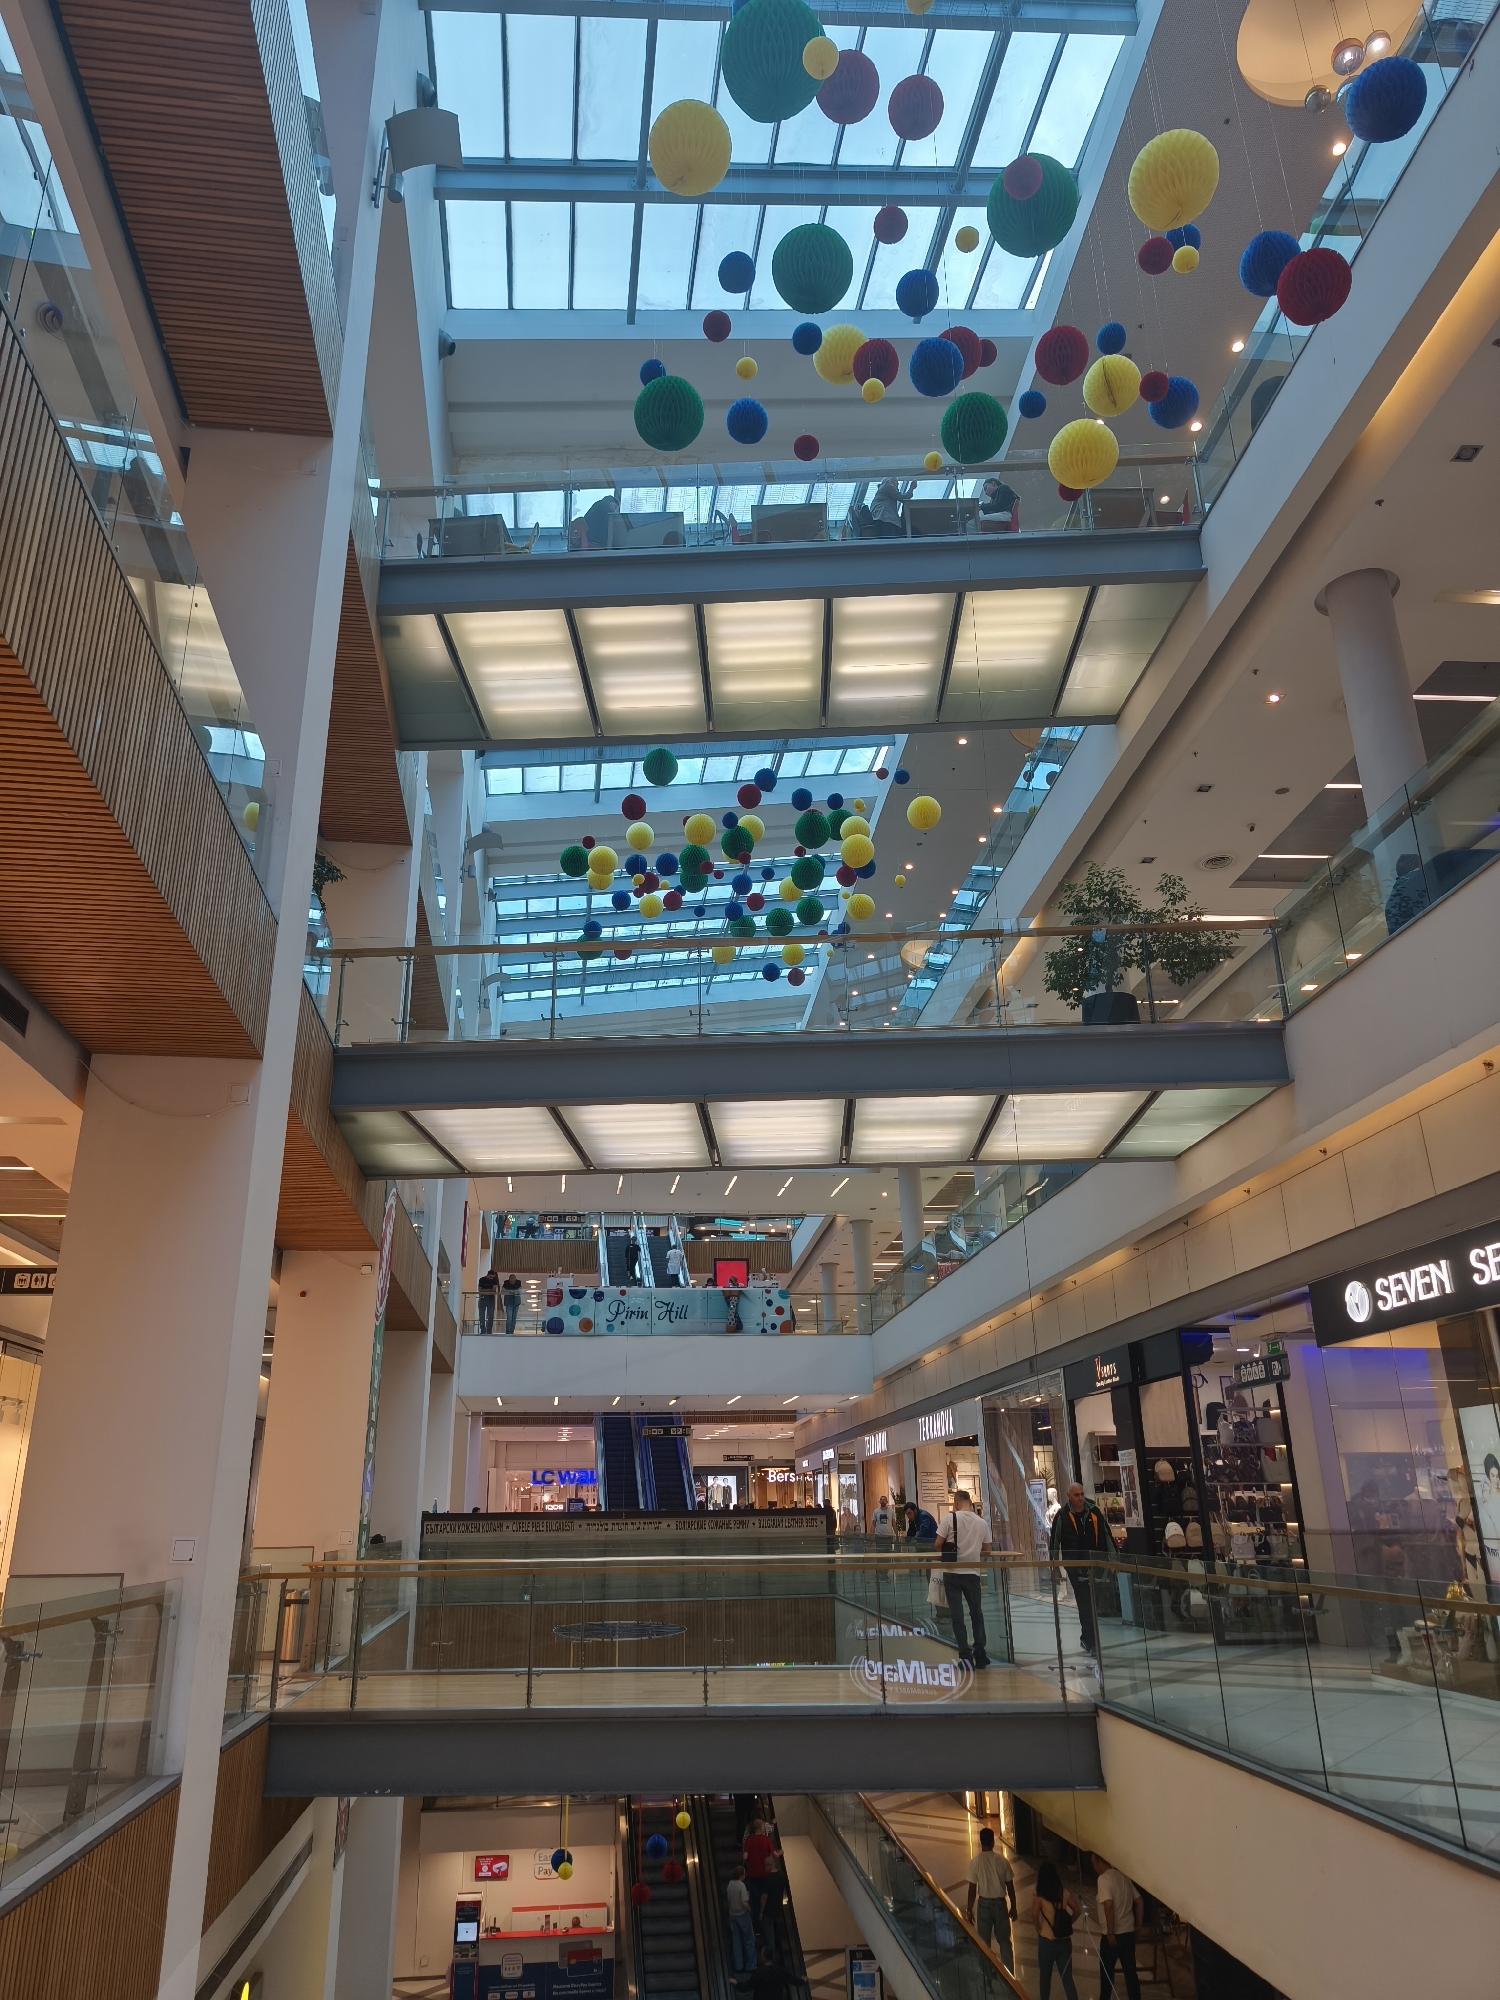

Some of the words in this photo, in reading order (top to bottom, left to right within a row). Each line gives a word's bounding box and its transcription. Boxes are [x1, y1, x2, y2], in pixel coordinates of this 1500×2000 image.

[1375, 1259, 1455, 1311] SEVEN
[606, 1299, 649, 1323] Pirin
[654, 1301, 689, 1323] Hill
[531, 1469, 555, 1485] LC
[538, 1852, 552, 1862] Eas
[538, 1866, 553, 1877] Pay
